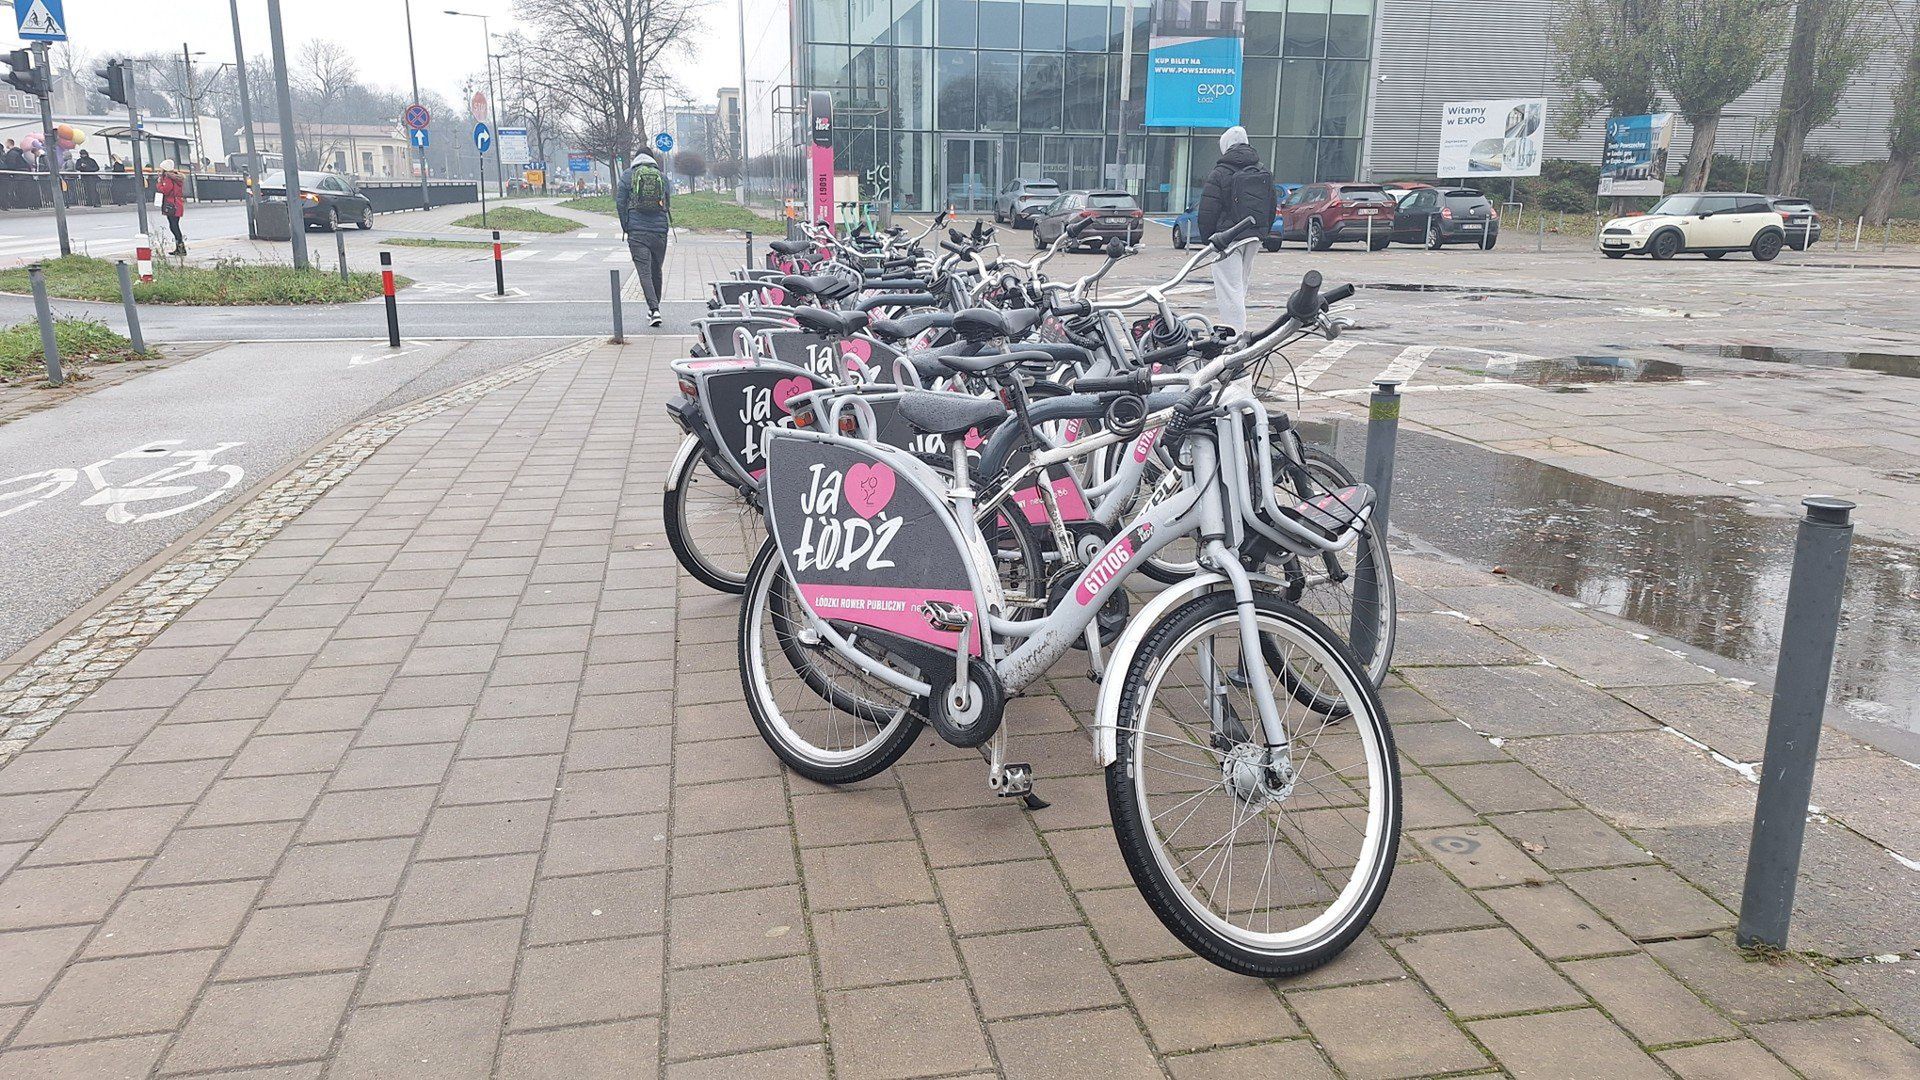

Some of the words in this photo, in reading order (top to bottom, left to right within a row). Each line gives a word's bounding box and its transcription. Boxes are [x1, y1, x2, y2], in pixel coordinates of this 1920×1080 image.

[1198, 83, 1234, 98] expo
[1448, 106, 1486, 115] Witamy
[1458, 117, 1485, 125] EXPO
[1084, 545, 1129, 595] 617106
[815, 595, 839, 607] ŁÓDZKI
[841, 599, 865, 609] ROWER
[867, 600, 906, 611] PUBLICZNY
